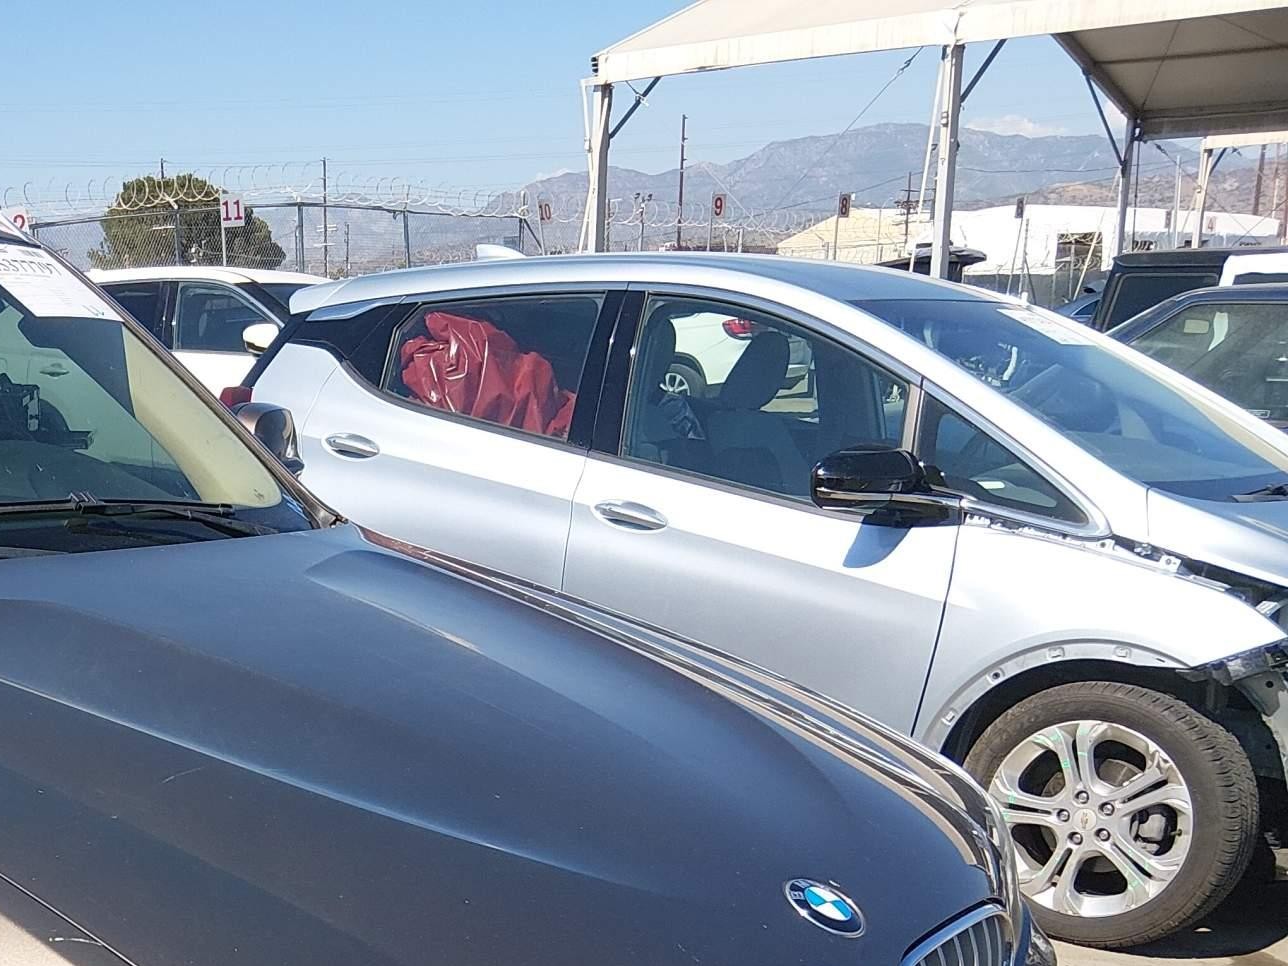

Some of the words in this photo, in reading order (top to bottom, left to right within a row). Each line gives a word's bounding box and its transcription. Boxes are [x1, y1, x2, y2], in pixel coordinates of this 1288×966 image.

[222, 200, 243, 221] 11
[539, 203, 552, 221] 10
[714, 197, 723, 216] 9
[840, 197, 848, 215] 8
